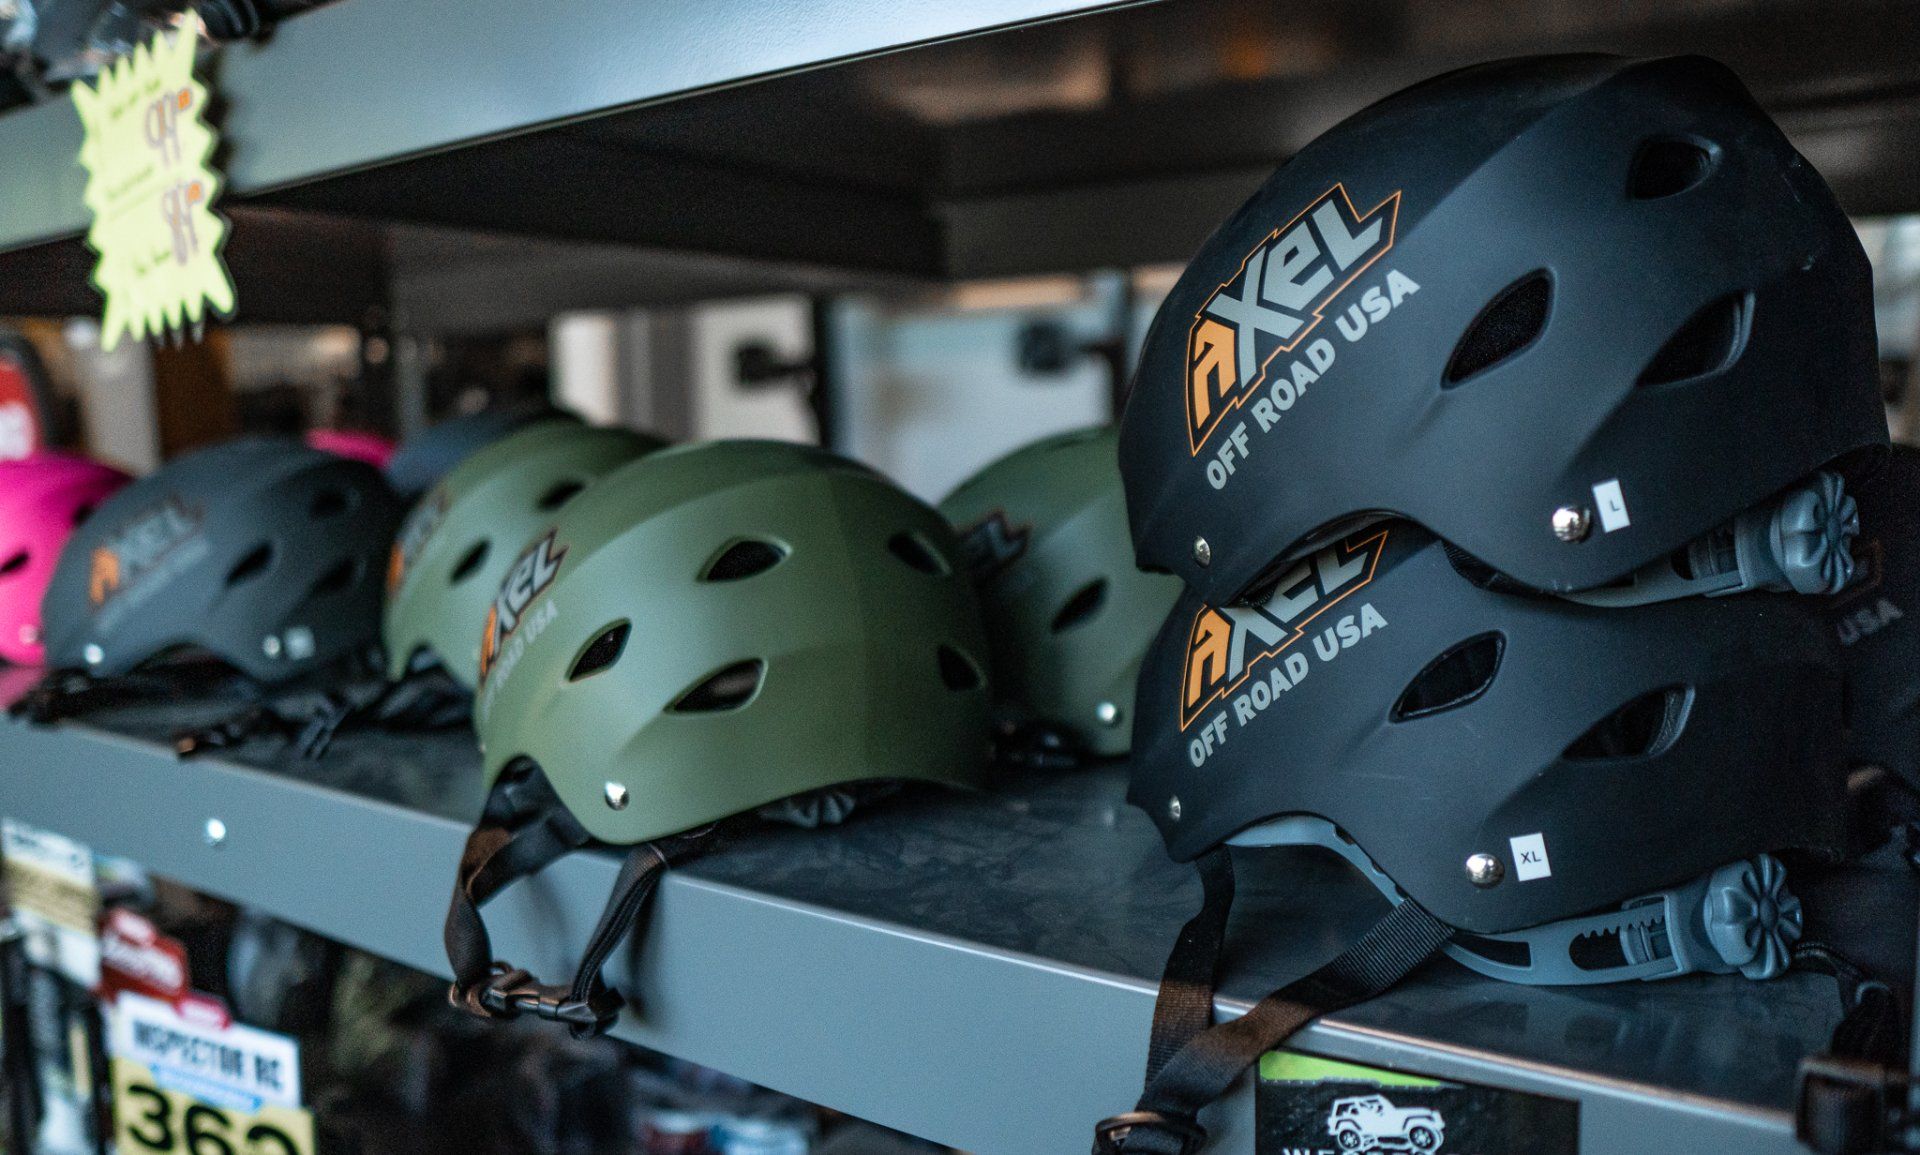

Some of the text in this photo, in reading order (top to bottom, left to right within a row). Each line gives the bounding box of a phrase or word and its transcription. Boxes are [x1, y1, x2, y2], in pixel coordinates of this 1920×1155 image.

[1206, 268, 1421, 490] OFF ROAD USA
[1610, 499, 1621, 512] L
[1189, 602, 1389, 769] OFF ROAD USA
[1520, 850, 1543, 865] XL
